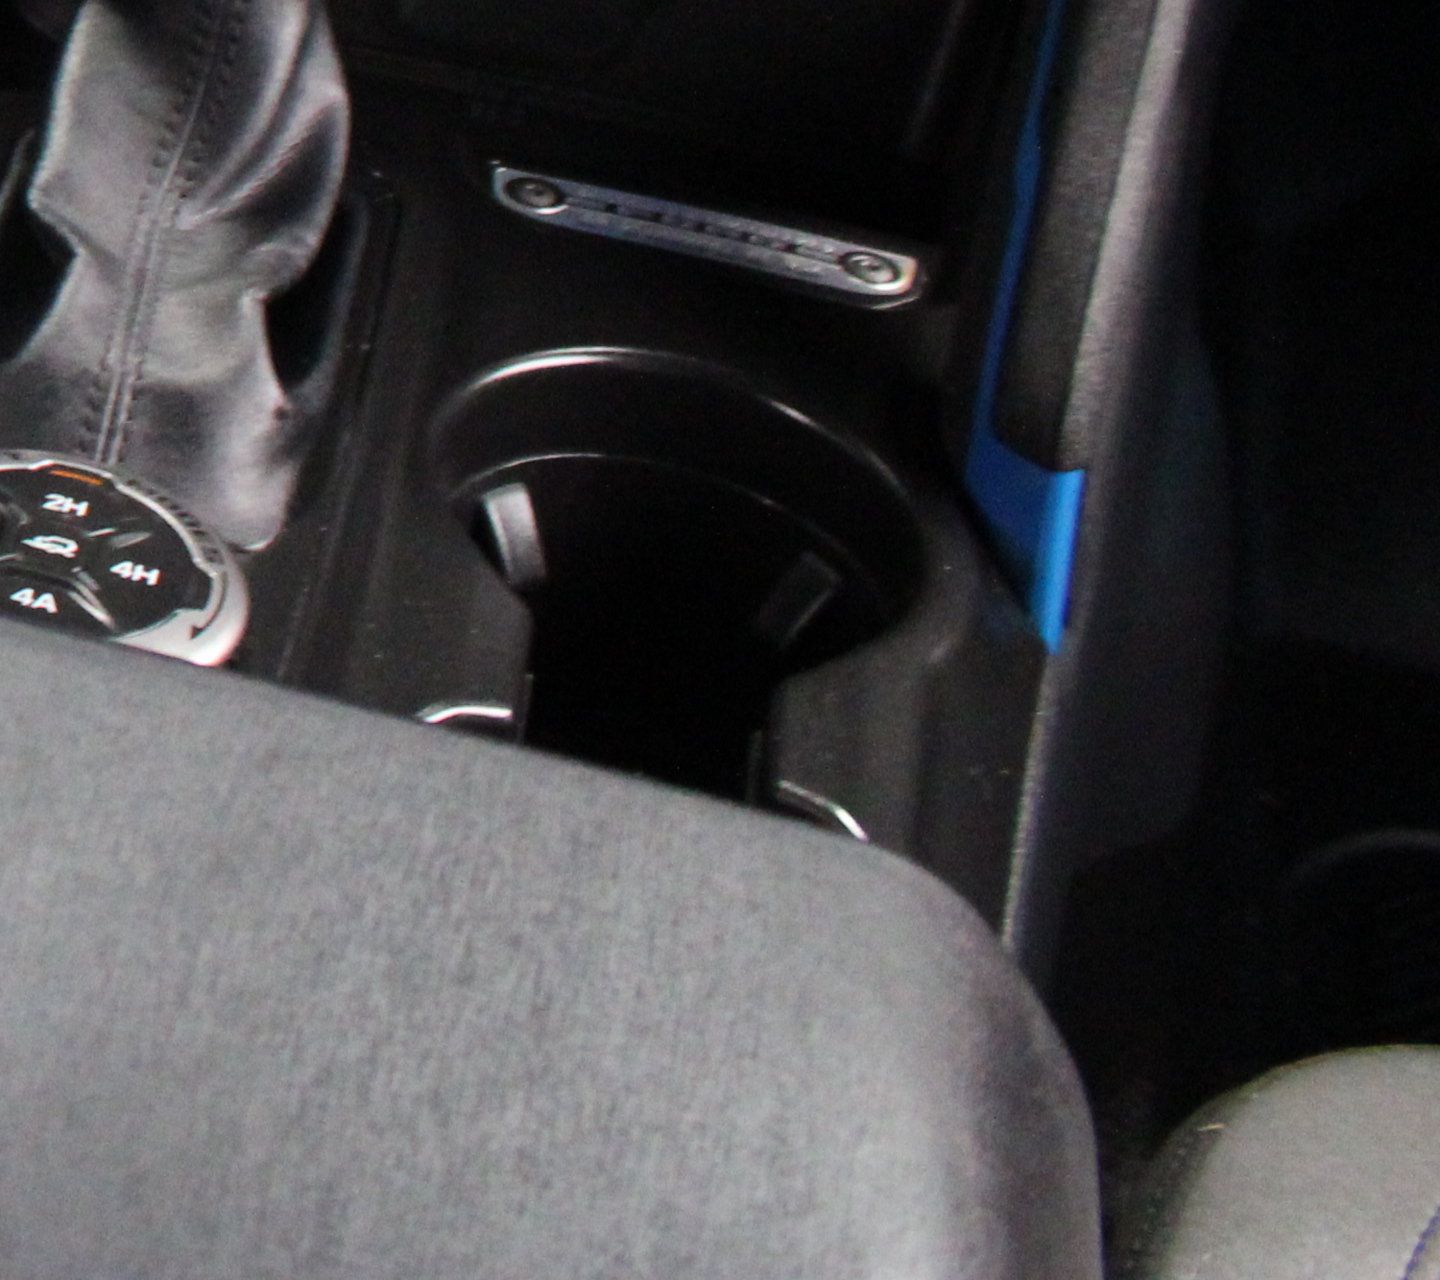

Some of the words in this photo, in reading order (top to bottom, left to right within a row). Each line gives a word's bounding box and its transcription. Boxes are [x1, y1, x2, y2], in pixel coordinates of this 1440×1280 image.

[40, 492, 90, 518] 2H
[109, 559, 163, 587] 4H
[9, 586, 60, 615] 4A
